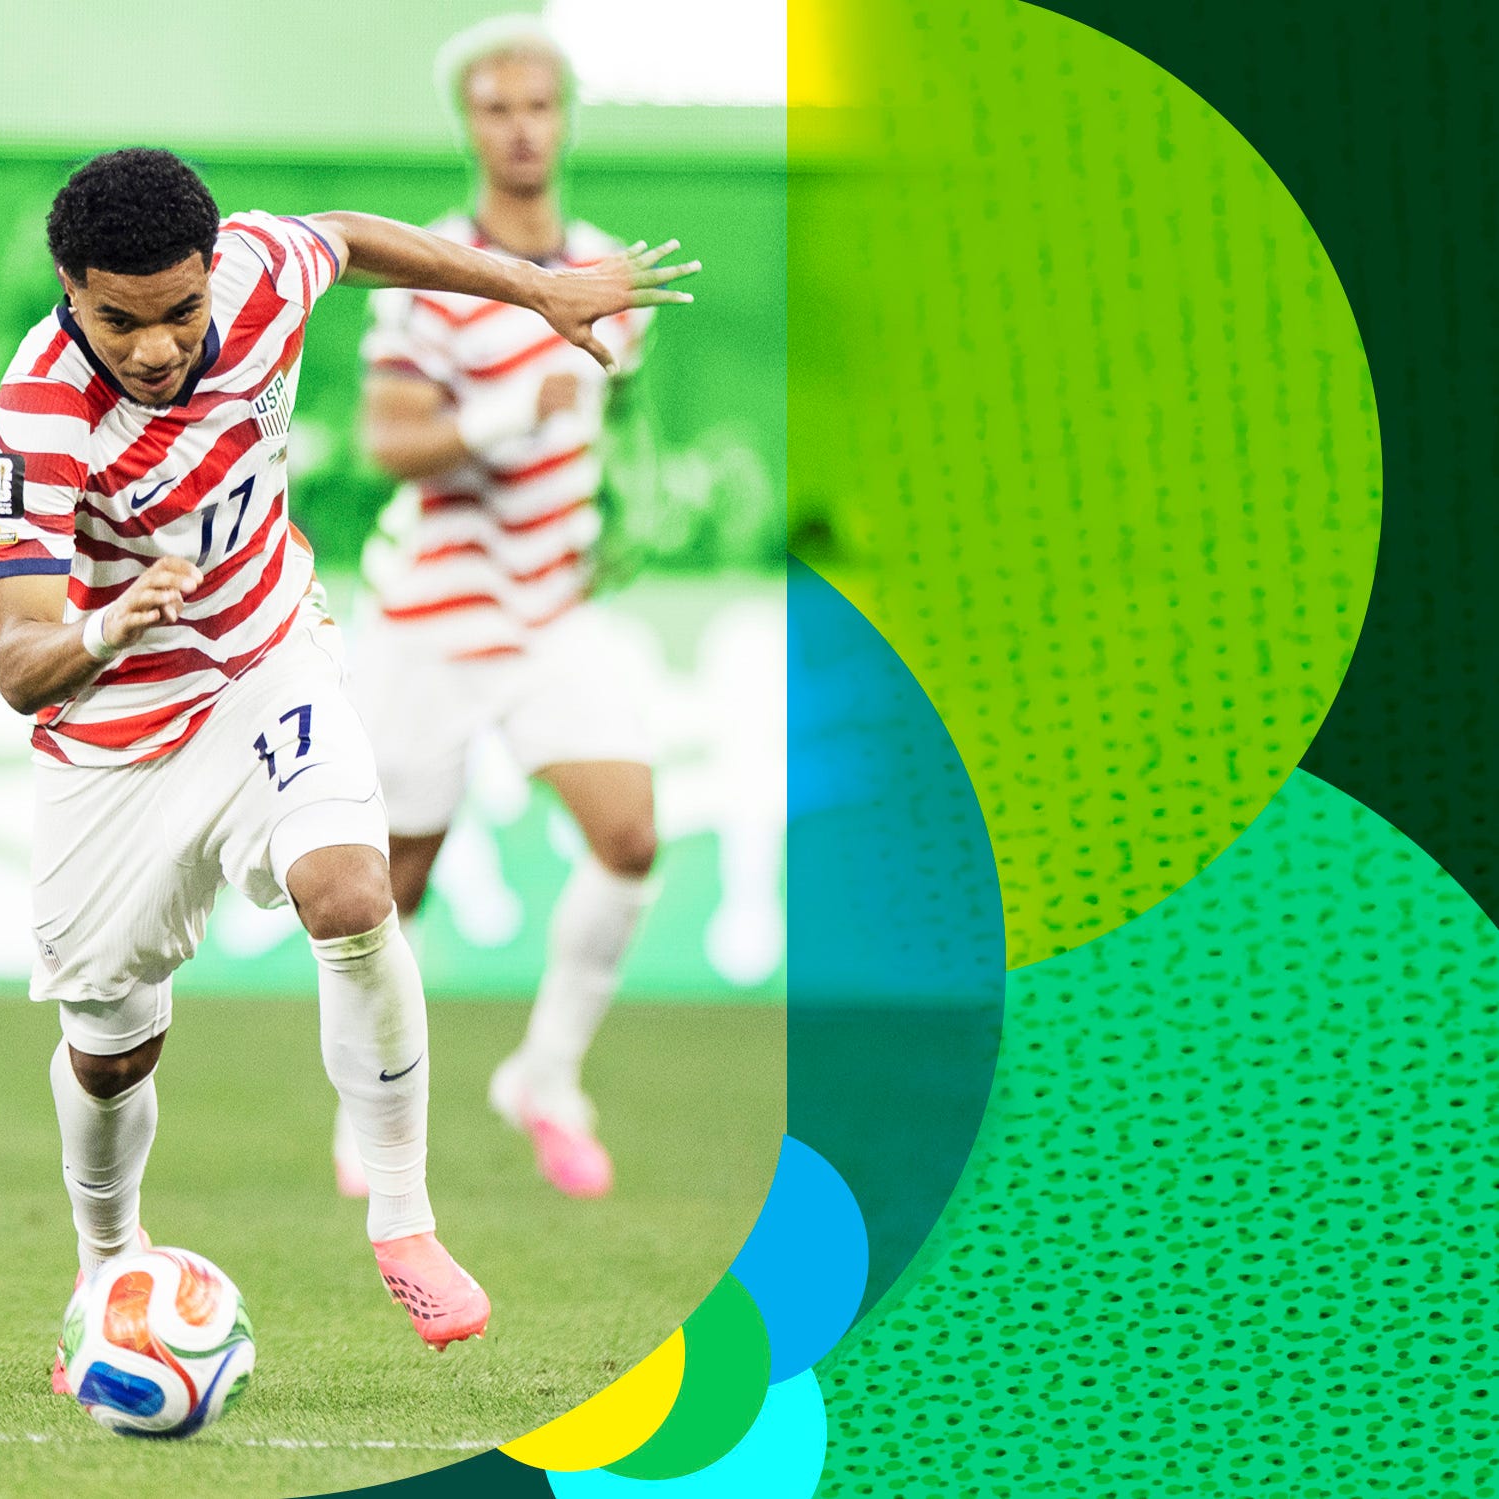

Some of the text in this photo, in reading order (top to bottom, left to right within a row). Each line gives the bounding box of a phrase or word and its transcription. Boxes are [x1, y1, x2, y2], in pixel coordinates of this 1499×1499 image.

[255, 376, 284, 414] USA
[196, 473, 256, 568] 17
[253, 704, 312, 781] 17
